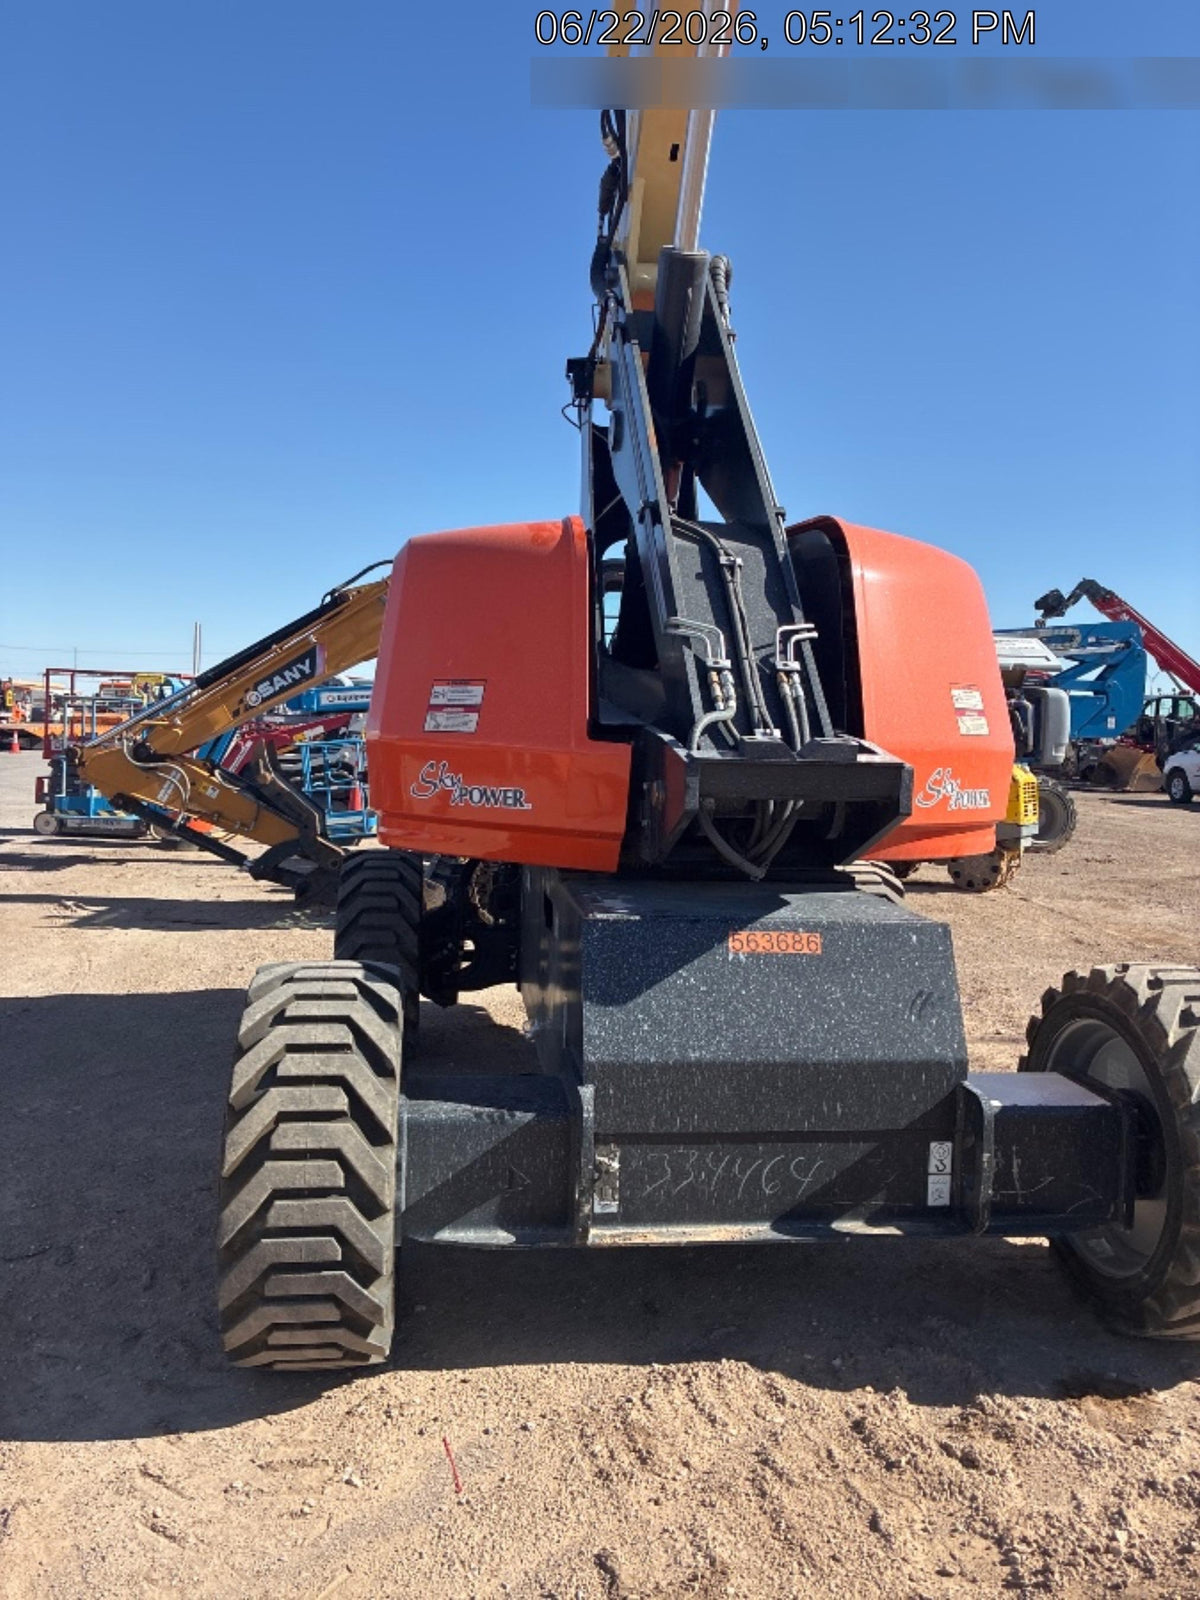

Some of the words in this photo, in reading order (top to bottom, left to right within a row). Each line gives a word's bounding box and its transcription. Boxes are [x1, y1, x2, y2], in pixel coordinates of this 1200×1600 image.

[256, 658, 312, 698] SANY
[410, 760, 462, 806] Sky
[458, 786, 526, 808] POWER
[731, 932, 819, 953] 563686
